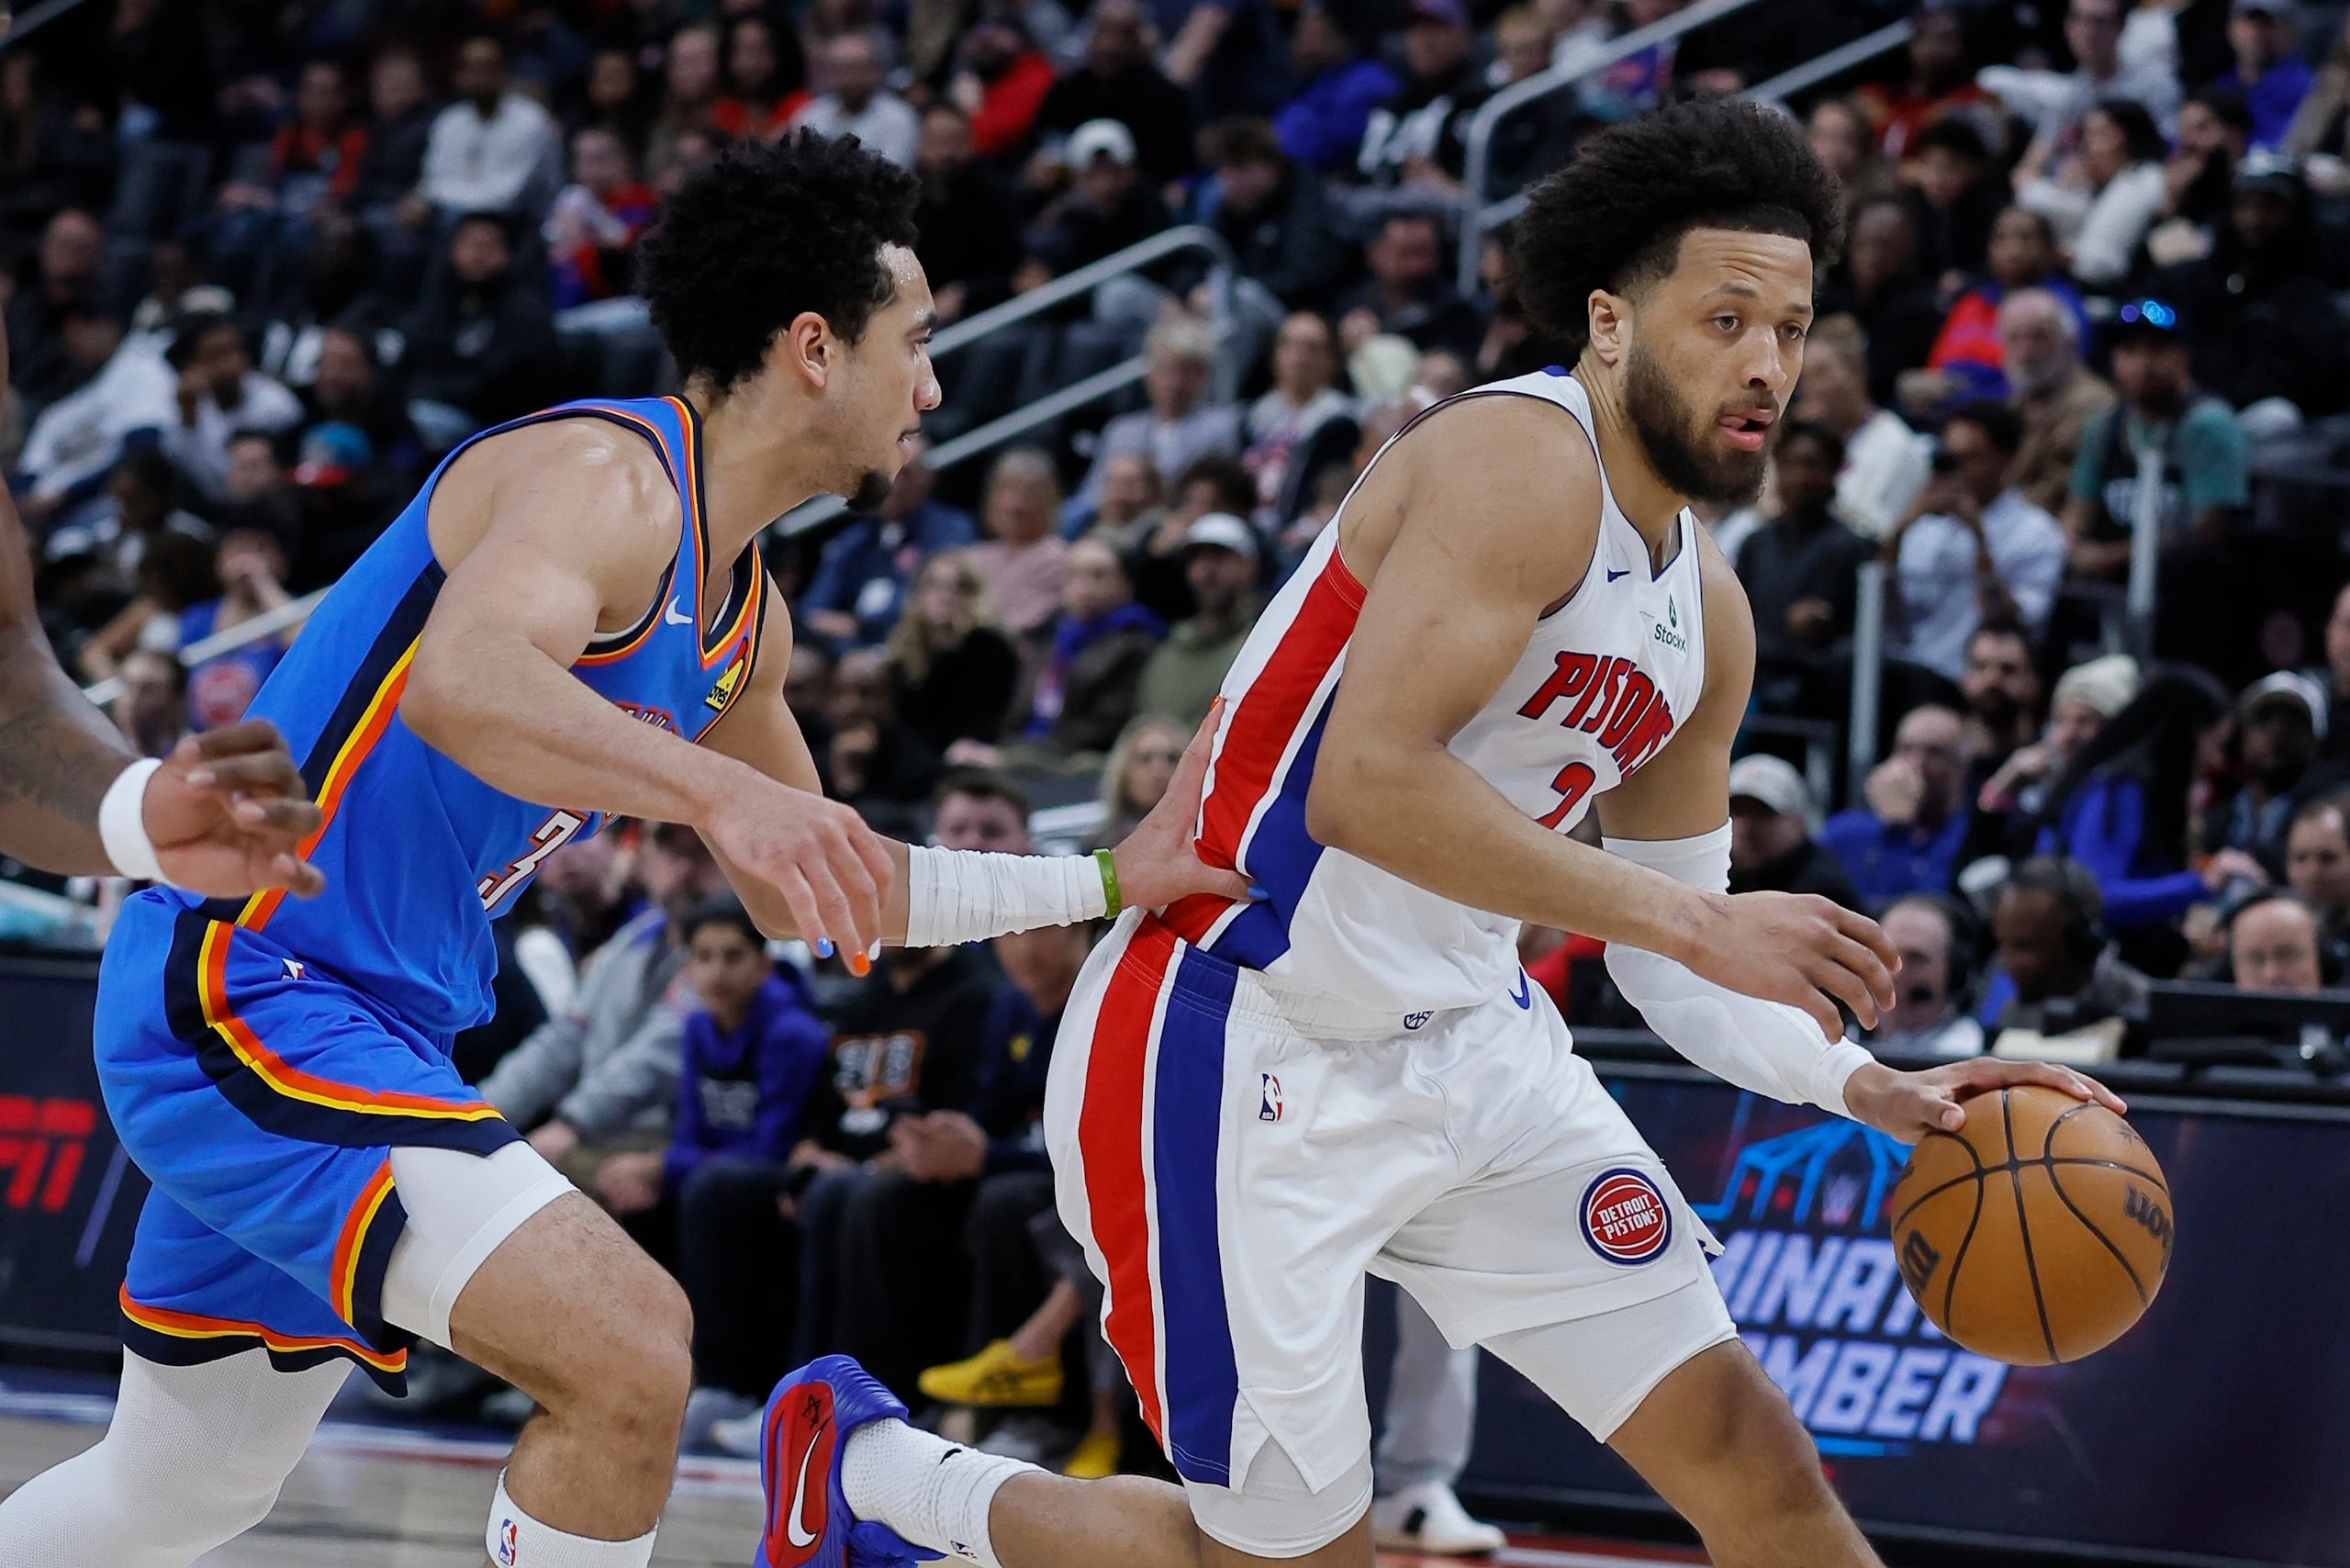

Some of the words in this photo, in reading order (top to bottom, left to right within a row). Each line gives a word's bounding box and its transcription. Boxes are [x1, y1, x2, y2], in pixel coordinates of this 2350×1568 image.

[1516, 650, 1674, 780] PISONS
[1536, 762, 1595, 830] 2
[476, 808, 589, 912] 3
[1597, 1193, 1651, 1226] DETROIT
[1603, 1208, 1659, 1241] PISTONS
[1740, 1331, 2009, 1445] MBER
